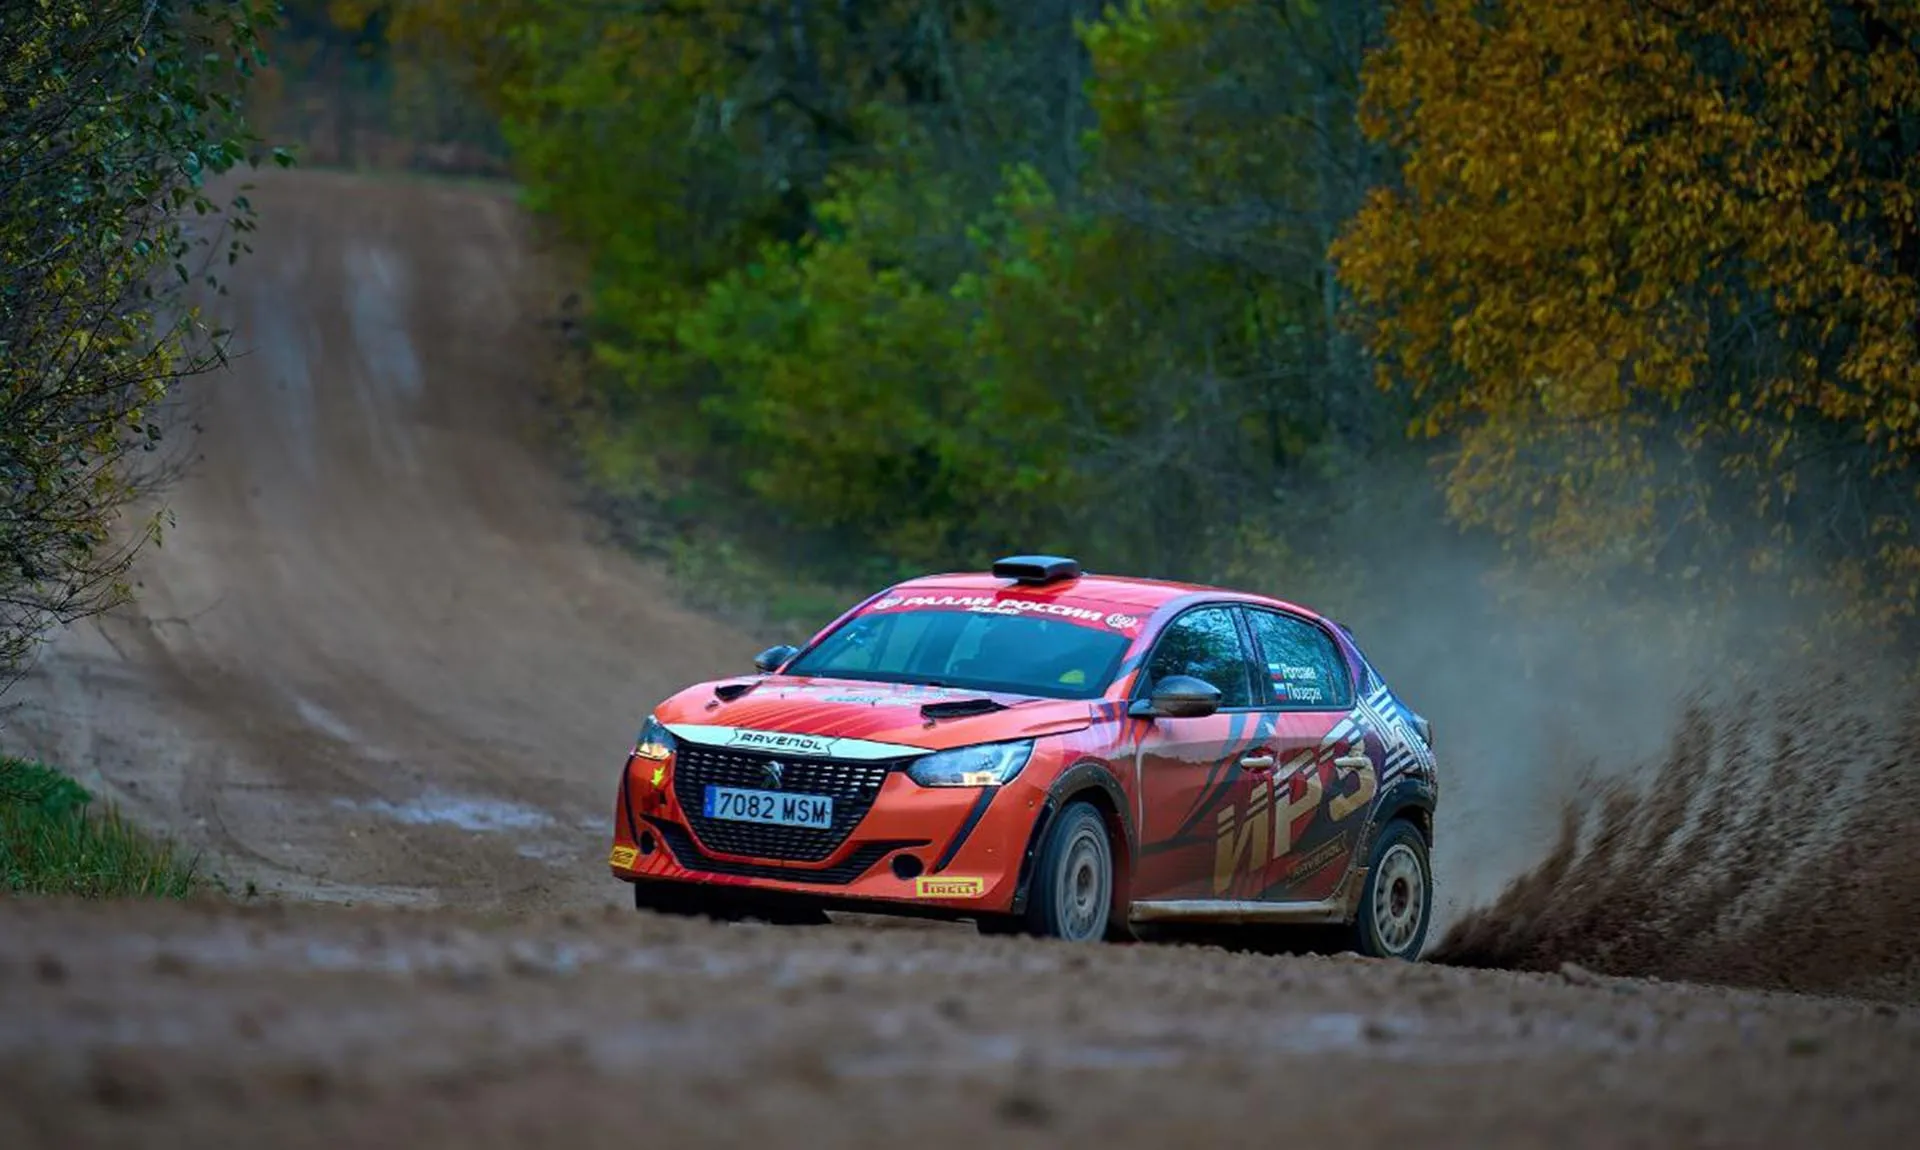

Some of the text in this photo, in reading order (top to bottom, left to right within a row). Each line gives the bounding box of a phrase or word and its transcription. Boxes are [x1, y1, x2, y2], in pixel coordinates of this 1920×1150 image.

[903, 596, 994, 607] РАЛЛИ
[997, 599, 1103, 621] РОССИИ
[740, 733, 822, 750] RAVENOL
[719, 793, 826, 824] 7082 MSM
[922, 881, 979, 894] PIRELLI
